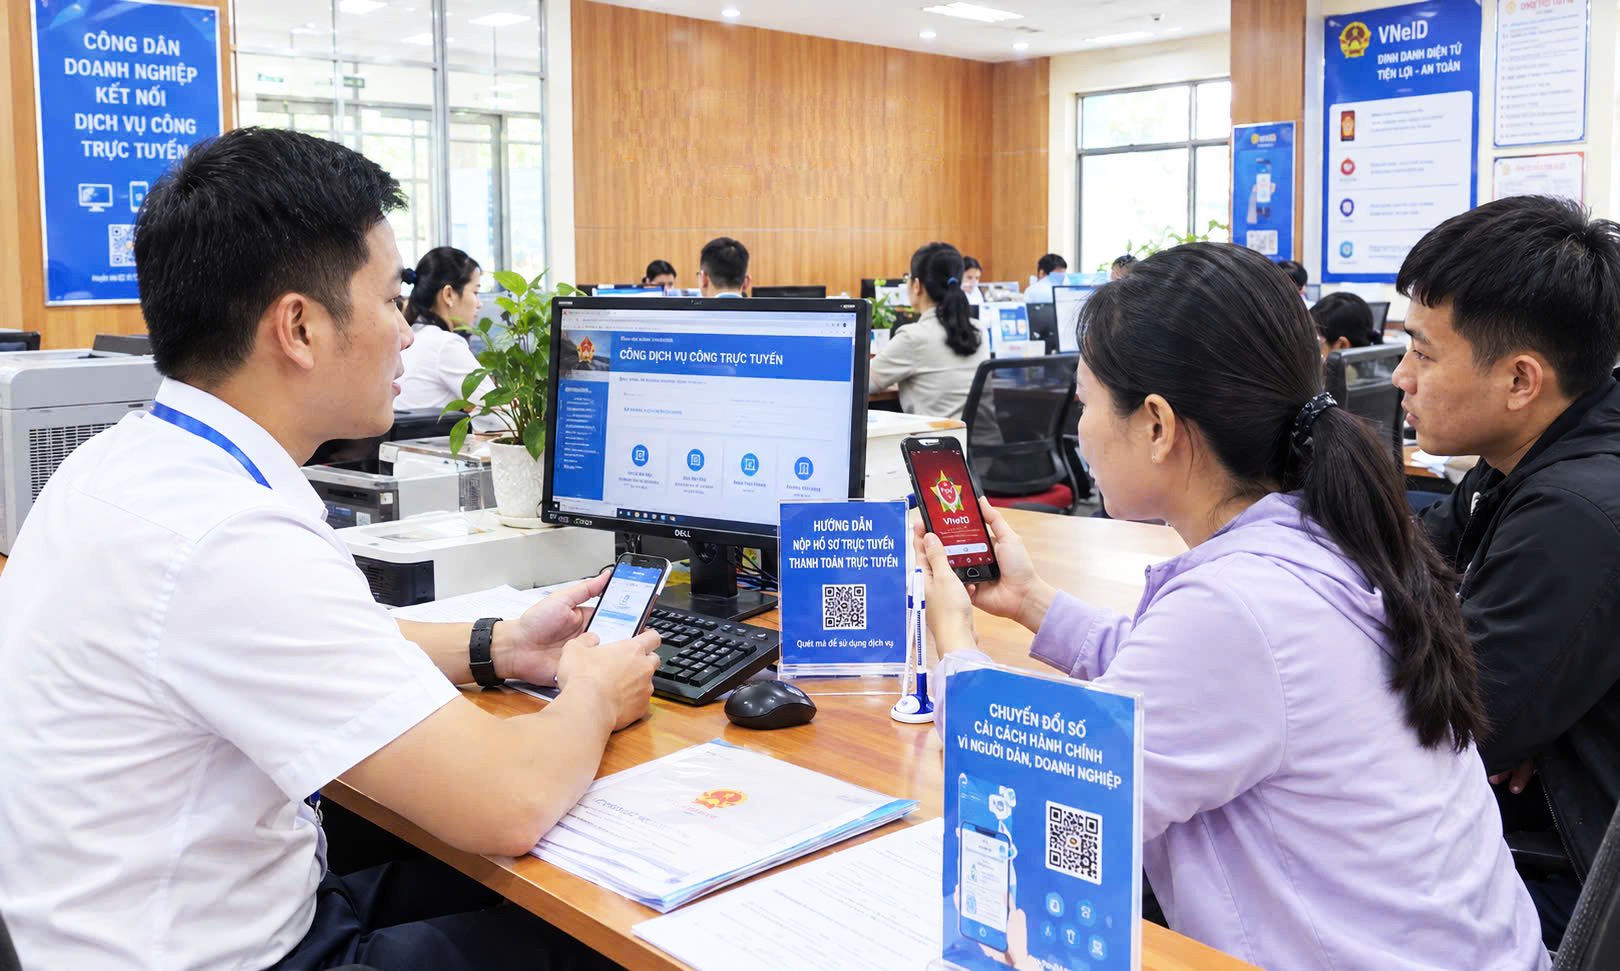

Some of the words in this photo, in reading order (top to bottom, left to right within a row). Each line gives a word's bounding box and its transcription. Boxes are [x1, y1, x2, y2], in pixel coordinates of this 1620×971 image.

[1378, 19, 1428, 44] VNeID
[83, 29, 137, 53] CÔNG
[143, 34, 180, 57] DÂN
[1400, 49, 1425, 63] DANH
[64, 57, 129, 79] DOANH
[135, 62, 198, 86] NGHIỆP
[1420, 63, 1434, 76] AN
[95, 82, 130, 105] KẾT
[135, 84, 167, 107] NỐI
[74, 112, 119, 134] DỊCH
[122, 115, 147, 136] VỤ
[150, 113, 197, 135] CÔNG
[81, 139, 129, 161] TRỰC
[648, 350, 672, 364] DỊCH
[674, 351, 688, 365] VỤ
[689, 349, 718, 363] CÔNG
[720, 352, 747, 367] TRỰC
[750, 351, 783, 365] TUYẾN
[674, 529, 691, 538] DELL
[813, 518, 849, 532] HƯỚNG
[827, 537, 840, 550] SƠ
[841, 538, 865, 553] TRỰC
[789, 557, 819, 569] THANH
[845, 556, 869, 571] TRỰC
[1067, 718, 1087, 739] SỐ
[995, 724, 1027, 746] CÁCH
[1064, 742, 1103, 765] CHÍNH
[1034, 754, 1076, 778] DOANH
[1077, 765, 1122, 790] NGHIỆP
